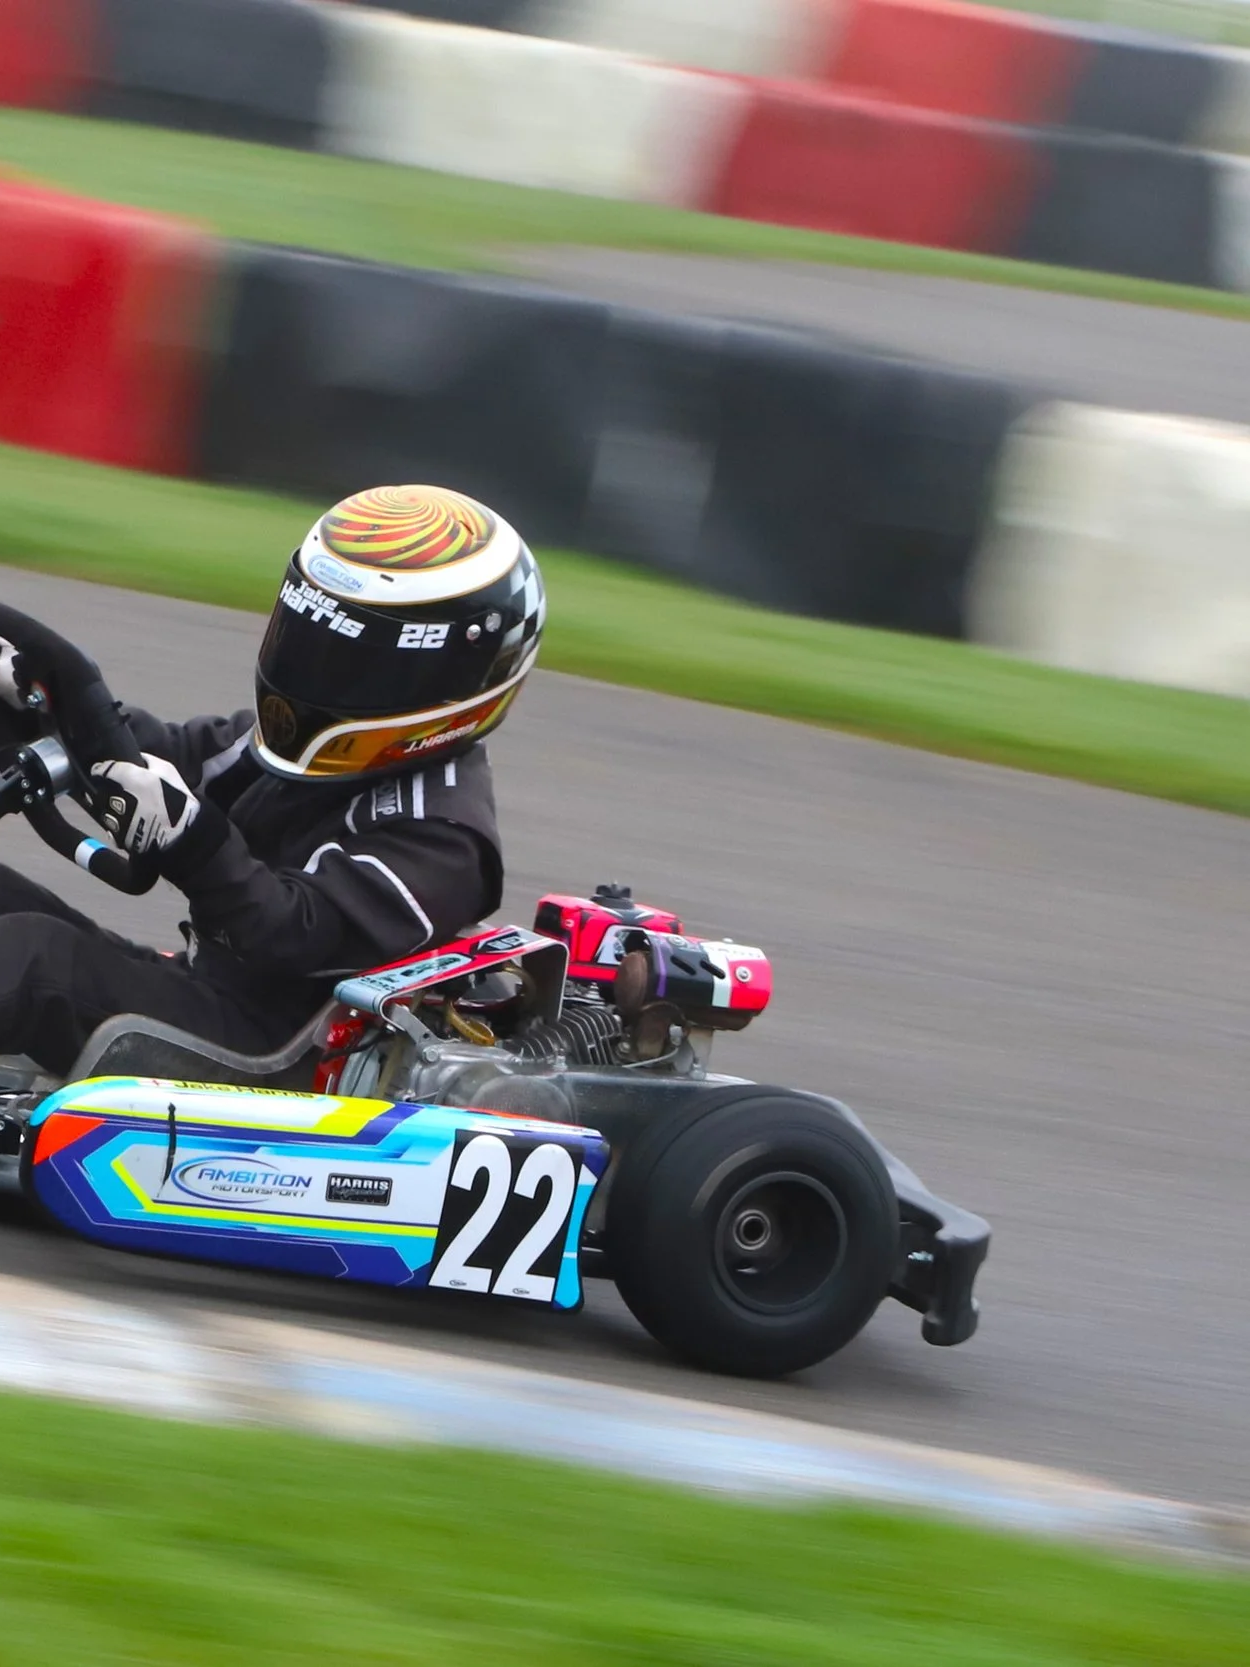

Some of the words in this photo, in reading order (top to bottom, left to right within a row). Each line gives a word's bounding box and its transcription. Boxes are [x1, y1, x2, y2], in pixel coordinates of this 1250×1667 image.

[296, 580, 339, 611] Jake
[279, 579, 366, 639] Harris
[396, 623, 451, 649] 22
[197, 1167, 313, 1189] AMBITION
[211, 1184, 308, 1198] MOTORSPORT
[330, 1176, 389, 1191] HARRIS
[428, 1133, 576, 1302] 22
